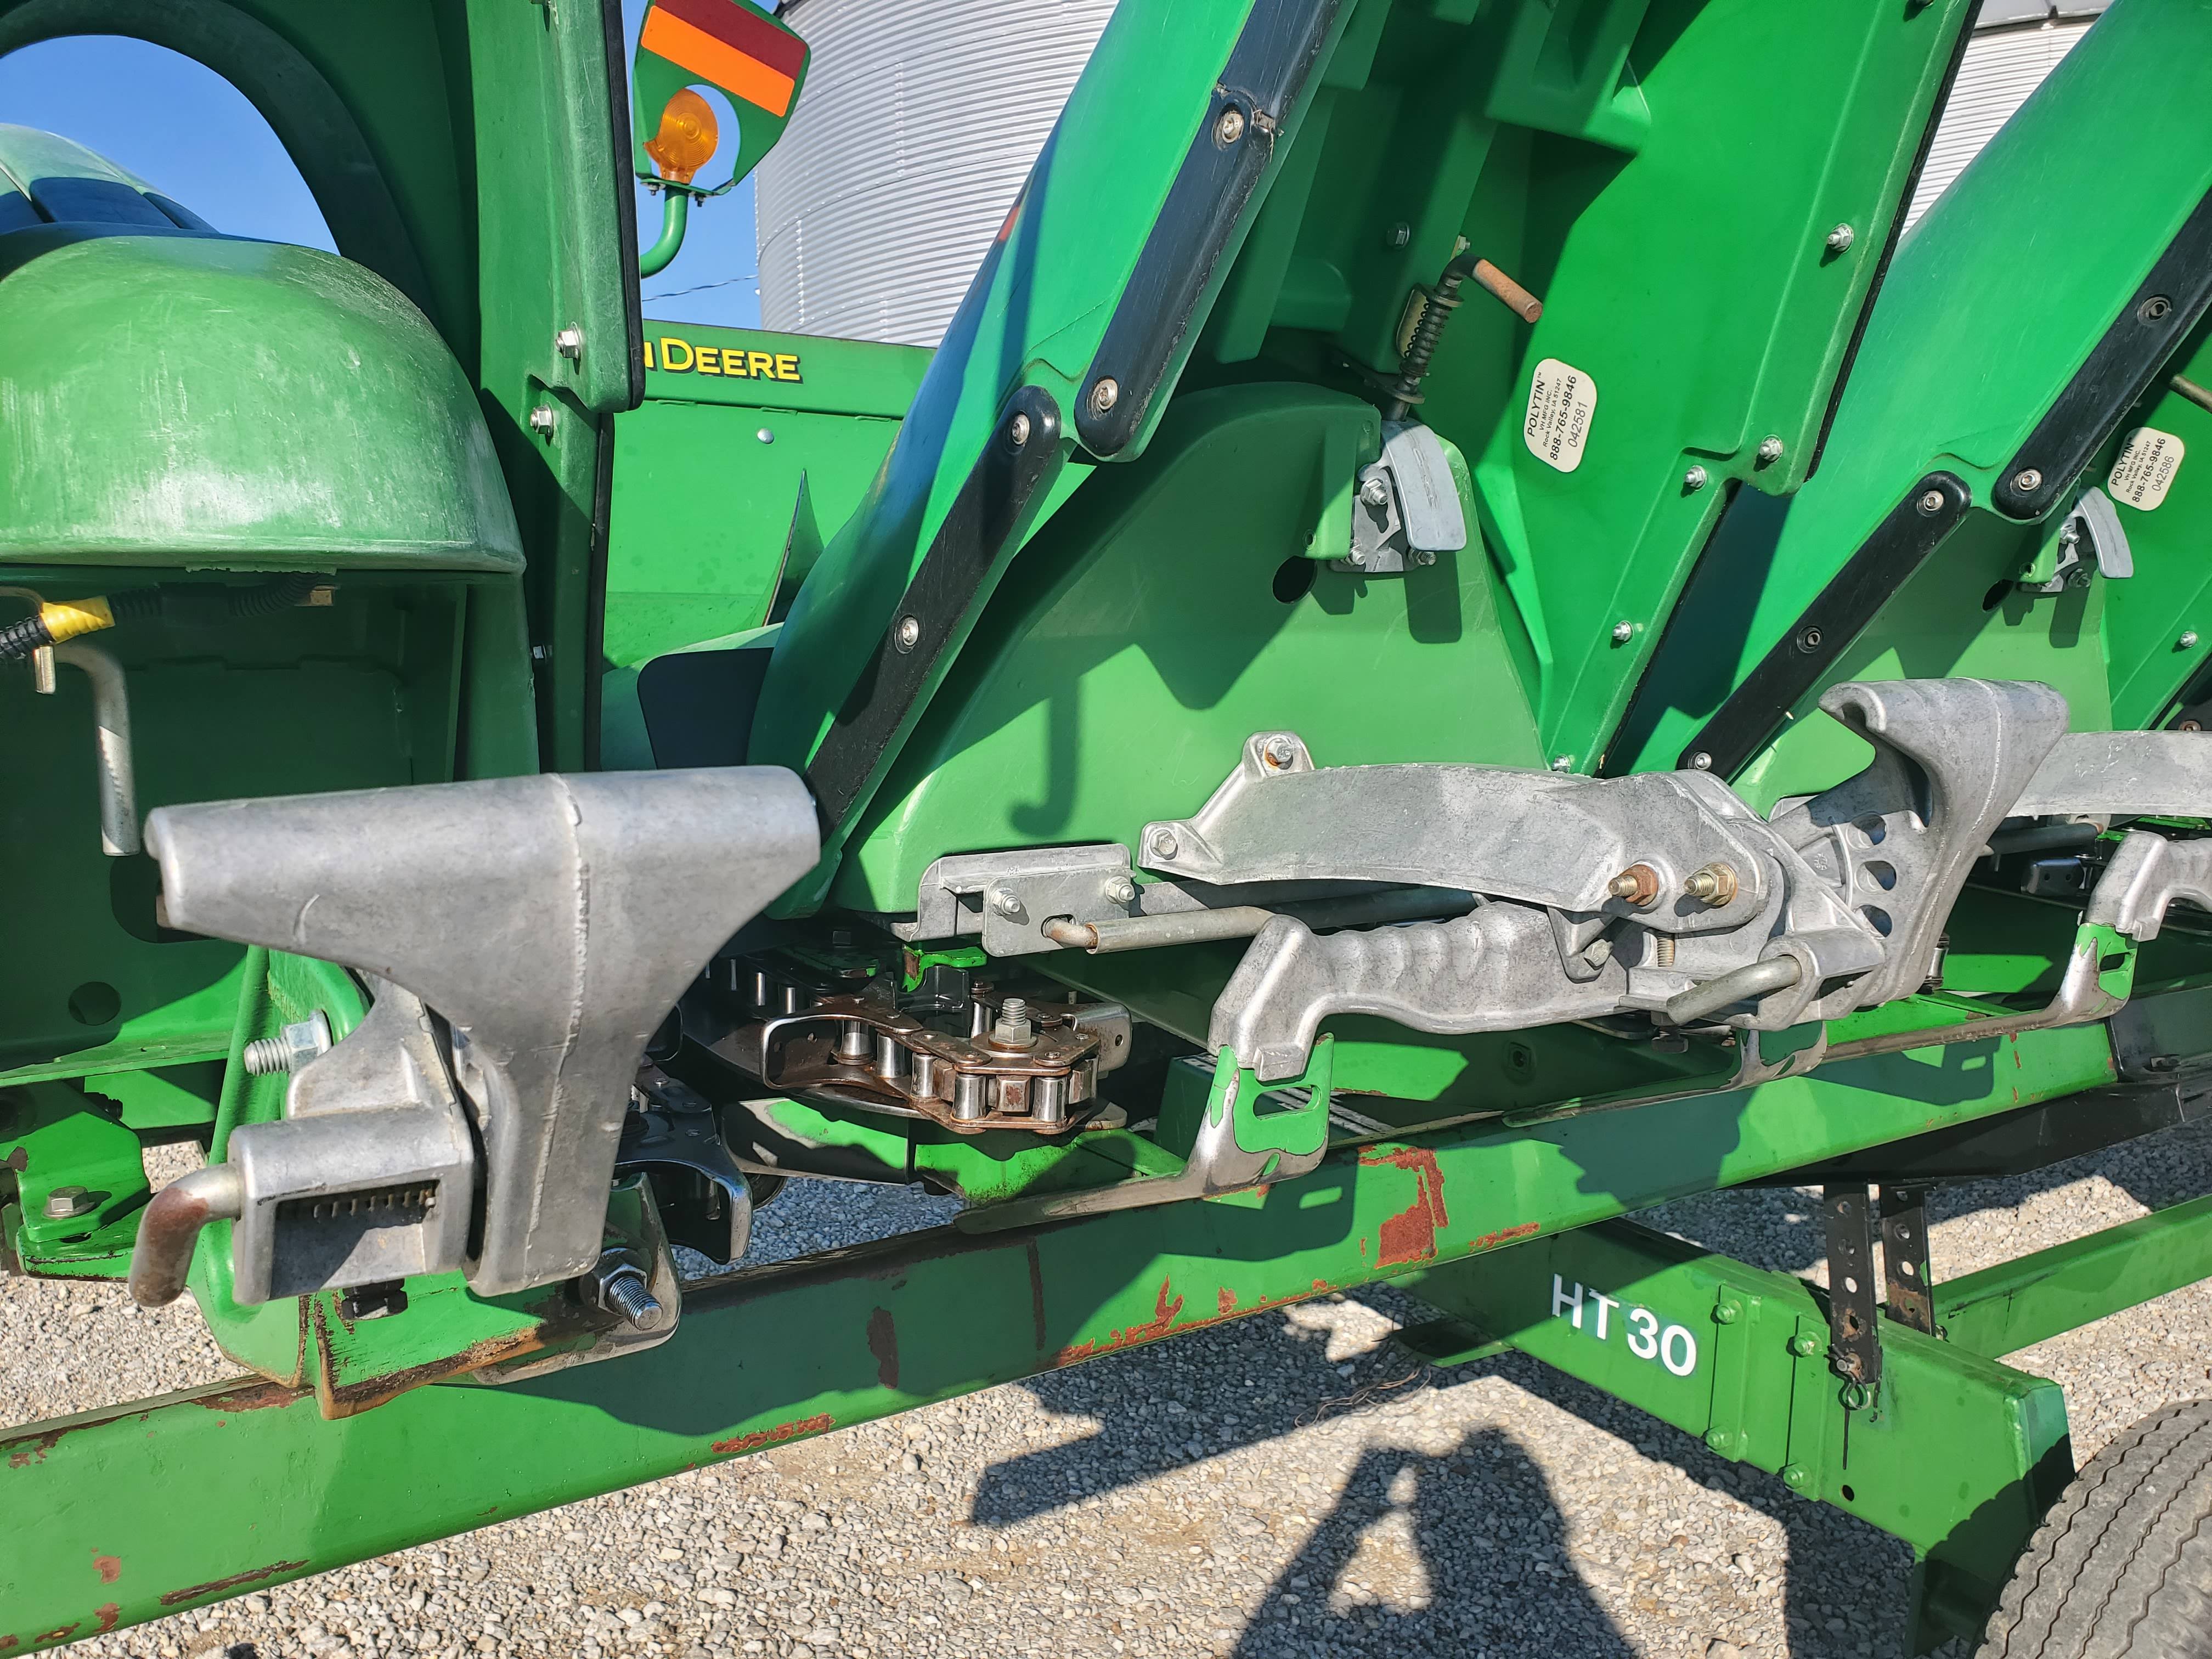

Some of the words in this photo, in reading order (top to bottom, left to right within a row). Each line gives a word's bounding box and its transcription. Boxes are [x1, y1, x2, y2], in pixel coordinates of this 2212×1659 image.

[661, 336, 803, 383] DEERE
[1552, 399, 1558, 408] IA
[1554, 378, 1562, 398] 51247
[1539, 422, 1545, 431] VH
[1546, 409, 1556, 429] Valley,
[1550, 375, 1577, 461] 888-765-9846
[1567, 401, 1588, 448] 042581
[2124, 473, 2130, 481] VH
[2128, 461, 2136, 473] MFG
[2126, 481, 2135, 493] Rock
[2141, 441, 2151, 457] 51247
[2132, 438, 2166, 503] 888-765-9846
[2152, 455, 2175, 491] 042586
[1552, 1273, 1620, 1340] HT
[1627, 1307, 1697, 1376] 30
